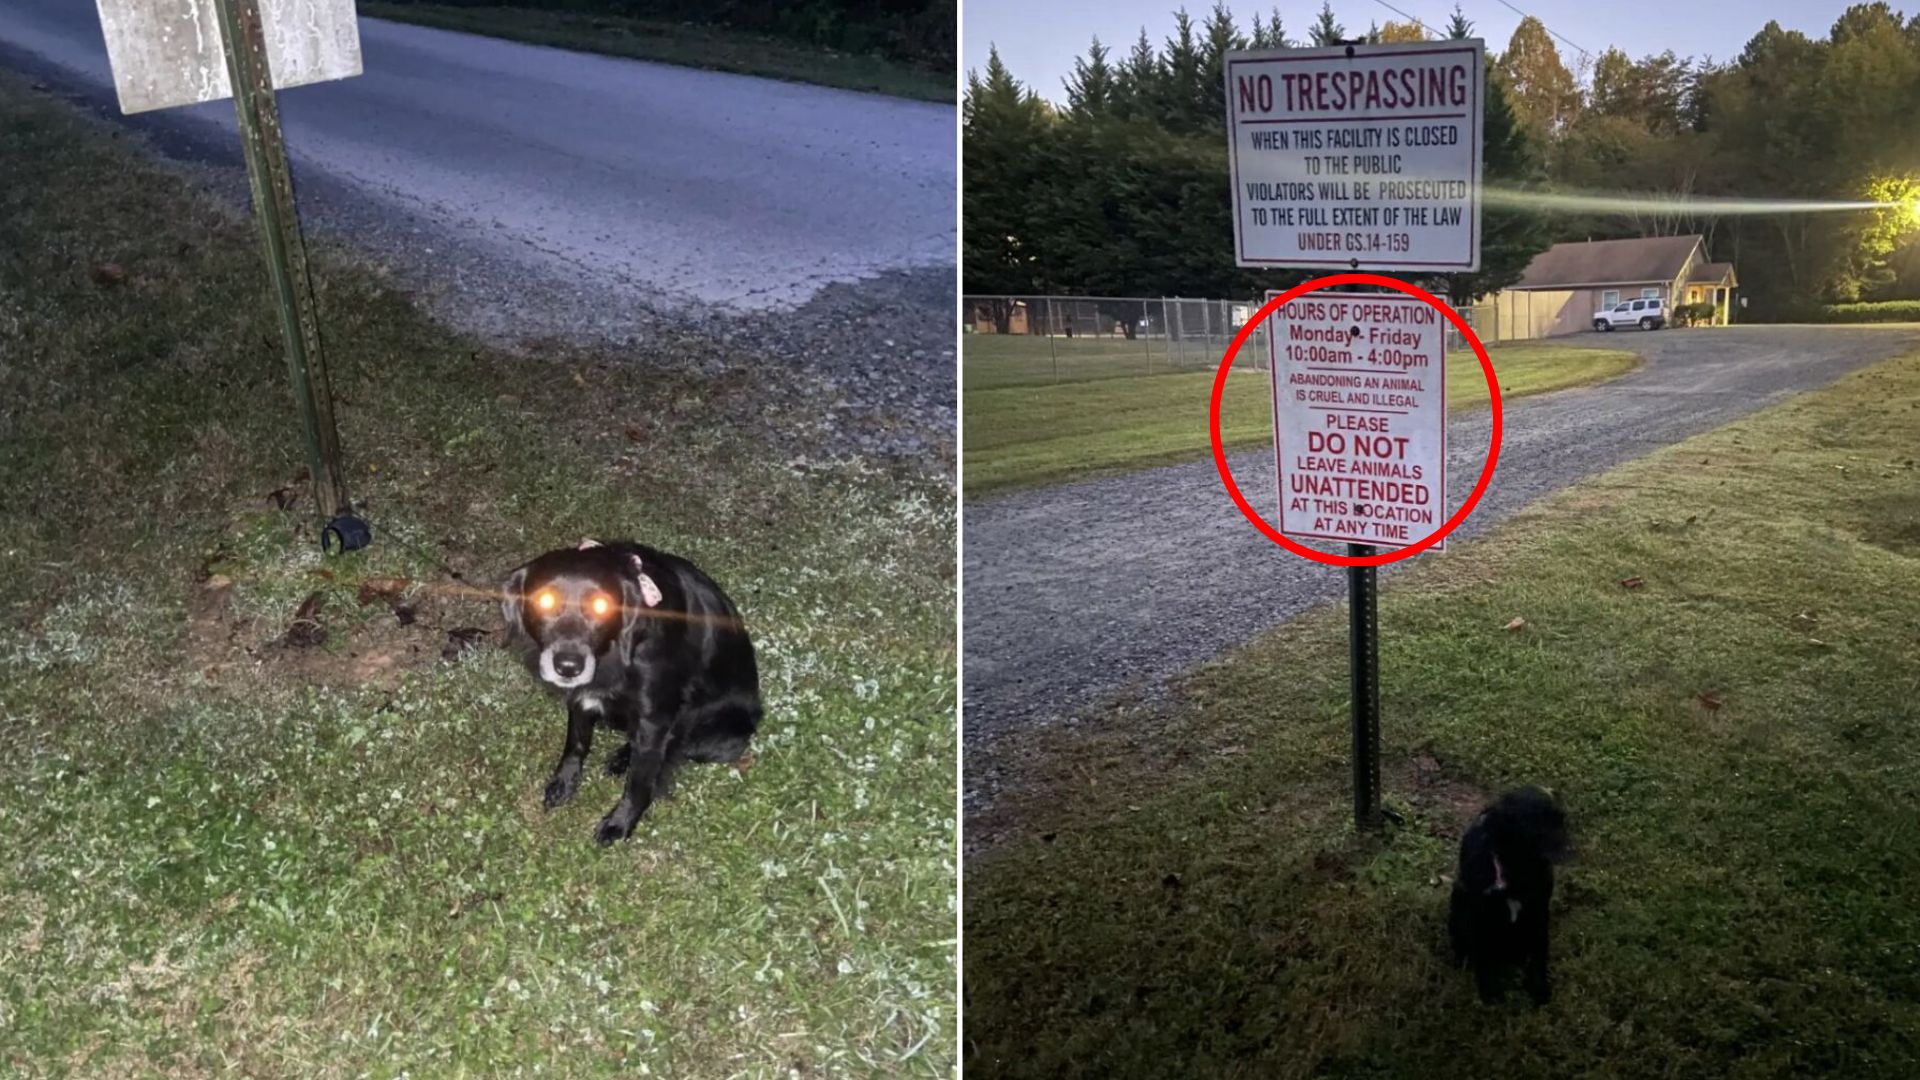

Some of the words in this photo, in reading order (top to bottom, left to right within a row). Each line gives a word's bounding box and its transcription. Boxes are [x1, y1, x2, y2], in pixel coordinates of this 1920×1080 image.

[1239, 74, 1273, 113] NO
[1282, 64, 1466, 111] TRESPASSING
[1251, 131, 1289, 150] WHEN
[1293, 130, 1322, 149] THIS
[1328, 128, 1381, 148] FACILITY
[1388, 127, 1400, 147] IS
[1405, 125, 1457, 146] CLOSED
[1304, 157, 1320, 175] TO
[1325, 156, 1348, 174] THE
[1354, 155, 1401, 174] PUBLIC
[1247, 182, 1314, 201] VIOLATORS
[1319, 182, 1349, 200] WILL
[1354, 182, 1370, 200] BE
[1379, 180, 1466, 199] PROSECUTED
[1252, 208, 1267, 226] TO
[1270, 208, 1294, 226] THE
[1299, 208, 1328, 226] FULL
[1333, 208, 1379, 225] EXTENT
[1384, 208, 1399, 225] OF
[1404, 208, 1427, 225] THE
[1433, 207, 1462, 226] LAW
[1298, 233, 1341, 251] UNDER
[1346, 233, 1409, 252] GS.14-159
[1278, 302, 1325, 321] HOURS
[1330, 304, 1348, 321] OF
[1353, 305, 1435, 324] OPERATION
[1290, 325, 1353, 347] Monday
[1370, 329, 1421, 349] Friday
[1286, 346, 1352, 364] 10:00am
[1368, 352, 1428, 370] 4:00pm
[1290, 374, 1361, 388] ABANDONING
[1365, 376, 1380, 389] AN
[1383, 377, 1424, 391] ANIMAL
[1296, 390, 1306, 400] IS
[1309, 390, 1343, 402] CRUEL
[1347, 392, 1369, 404] AND
[1373, 394, 1419, 407] ILLEGAL
[1327, 414, 1389, 432] PLEASE
[1309, 431, 1345, 453] DO
[1355, 434, 1409, 459] NOT
[1298, 456, 1345, 473] LEAVE
[1351, 461, 1422, 479] ANIMALS
[1291, 474, 1429, 505] UNATTENDED
[1291, 498, 1309, 511] AT
[1314, 500, 1348, 514] THIS
[1314, 518, 1333, 531] AT
[1336, 519, 1367, 536] ANY
[1372, 522, 1408, 539] TIME
